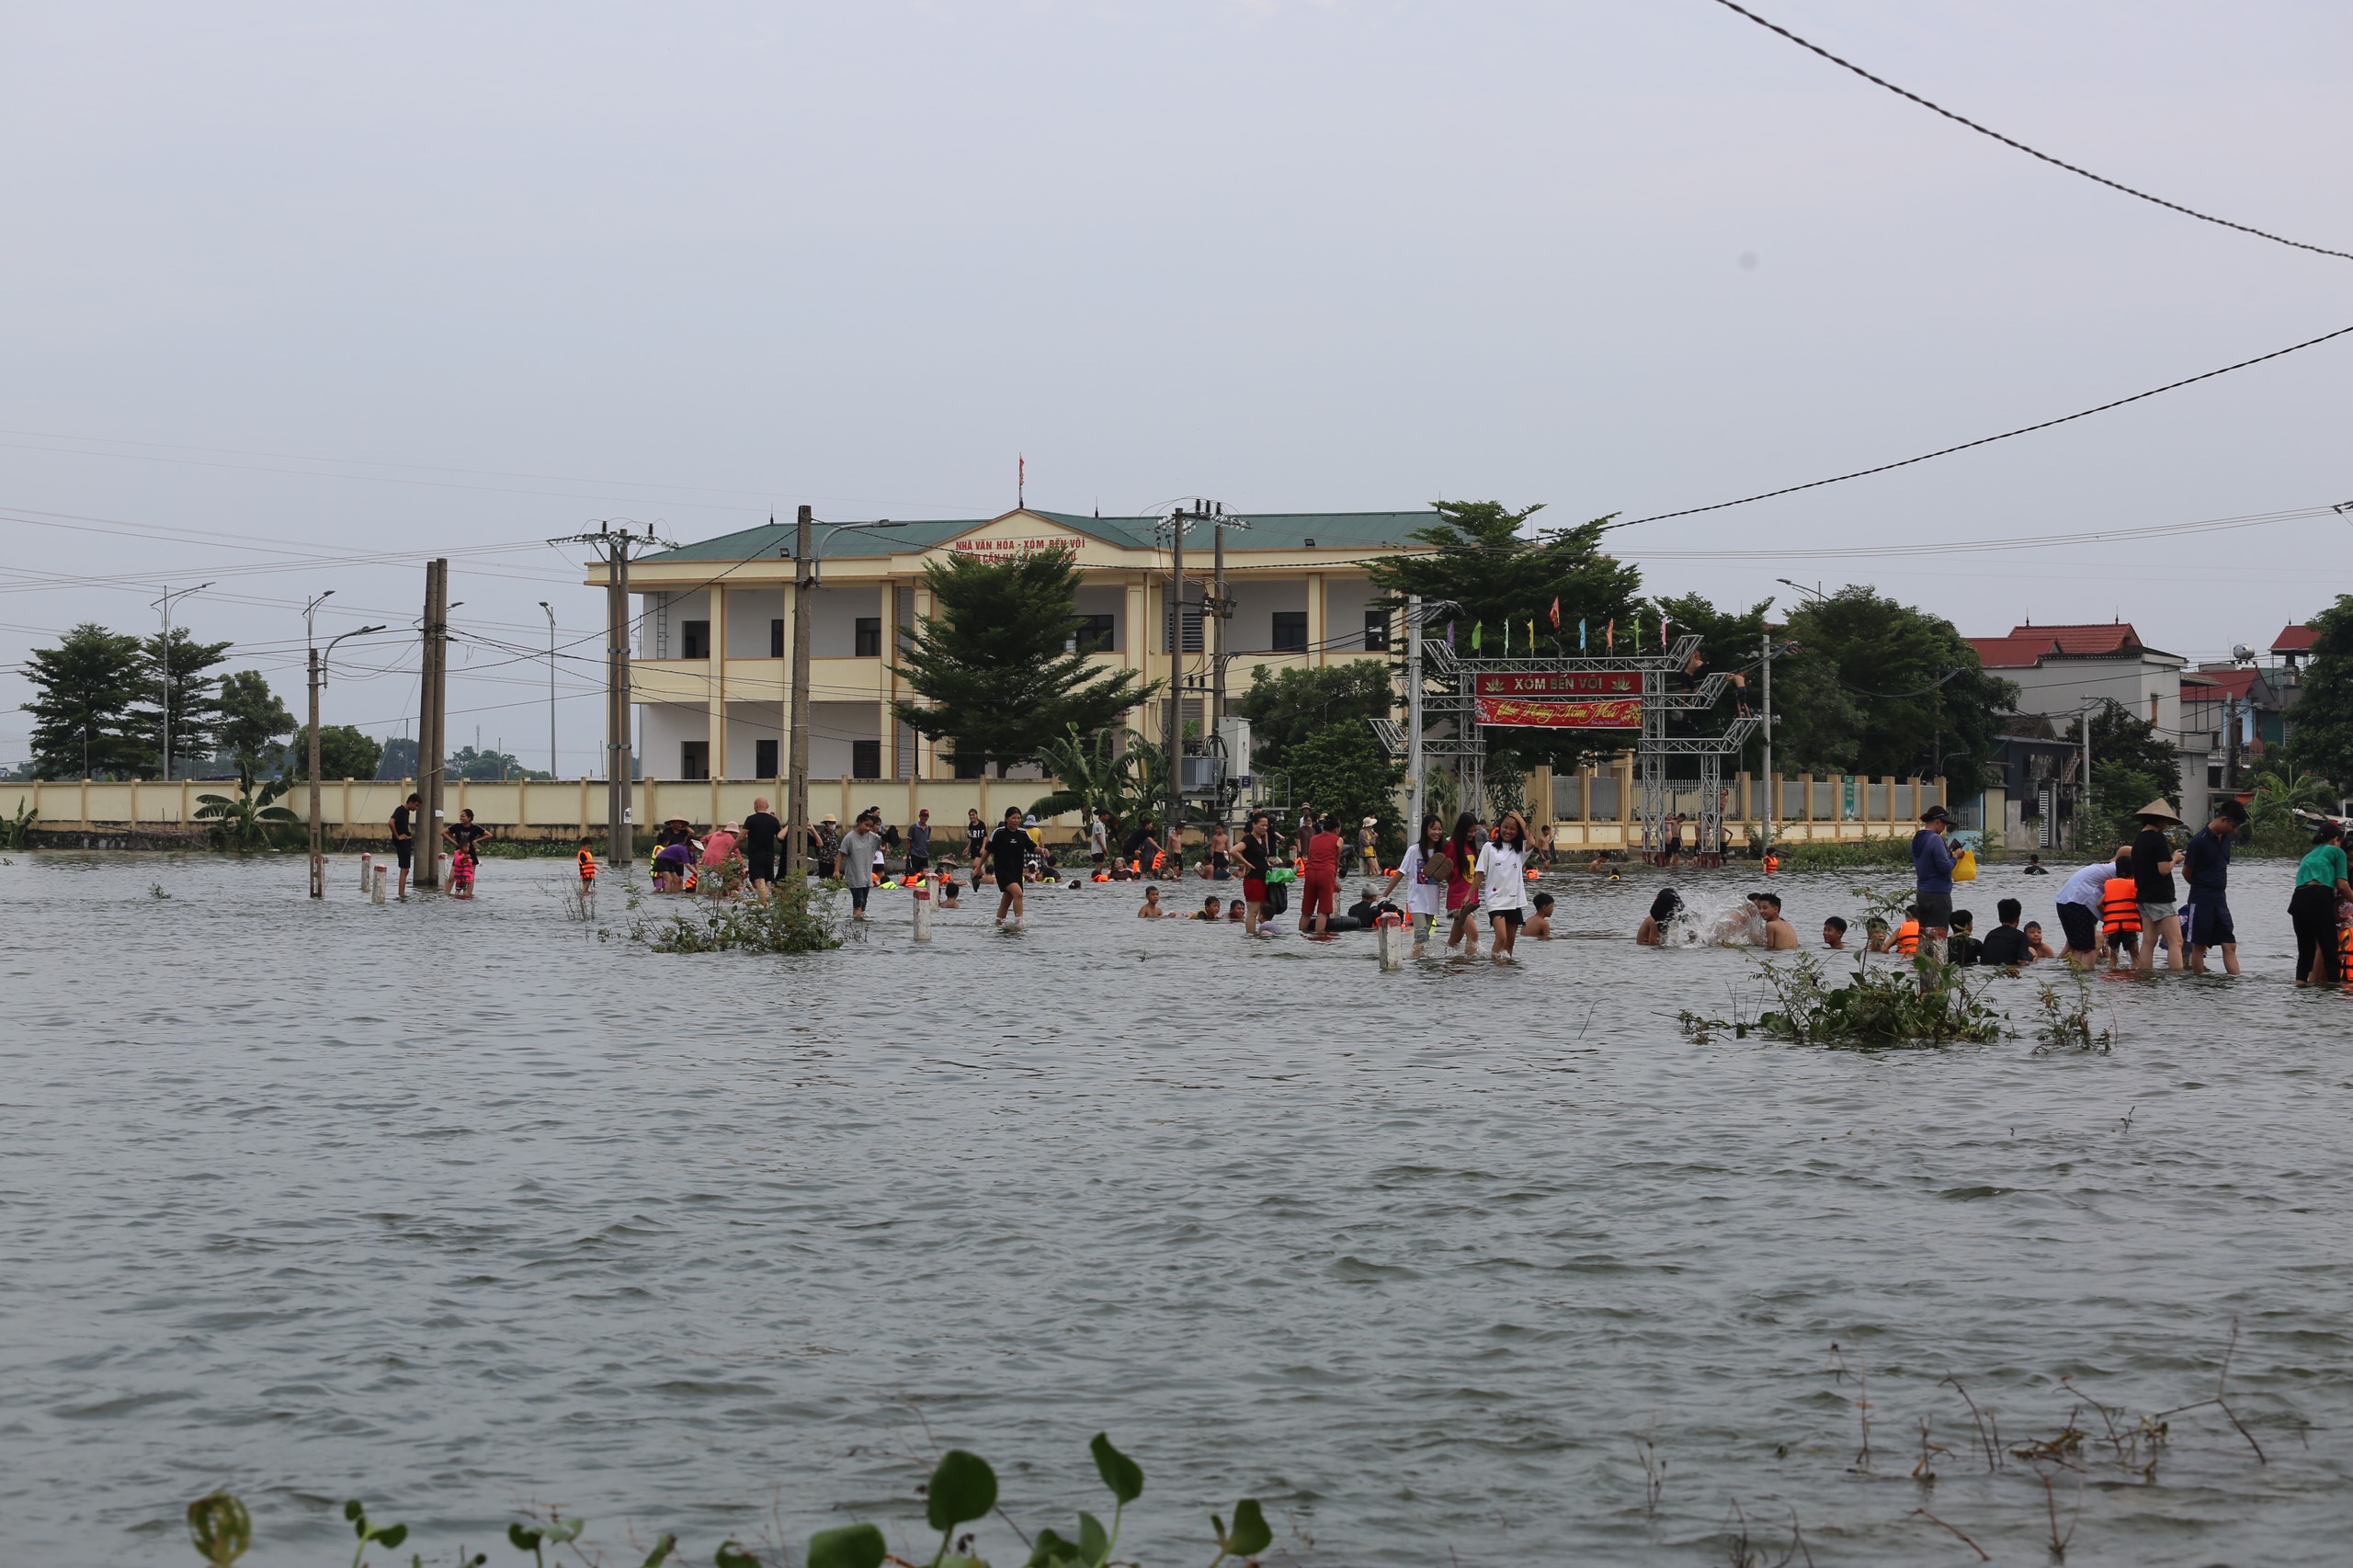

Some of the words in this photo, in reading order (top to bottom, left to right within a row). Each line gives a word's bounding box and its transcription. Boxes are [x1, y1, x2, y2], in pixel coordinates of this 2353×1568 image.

[975, 539, 992, 550] VĂN
[996, 539, 1014, 550] HÓA
[1024, 538, 1044, 549] XÓM
[1515, 674, 1546, 689] XÓM
[1550, 674, 1574, 689] BẾN
